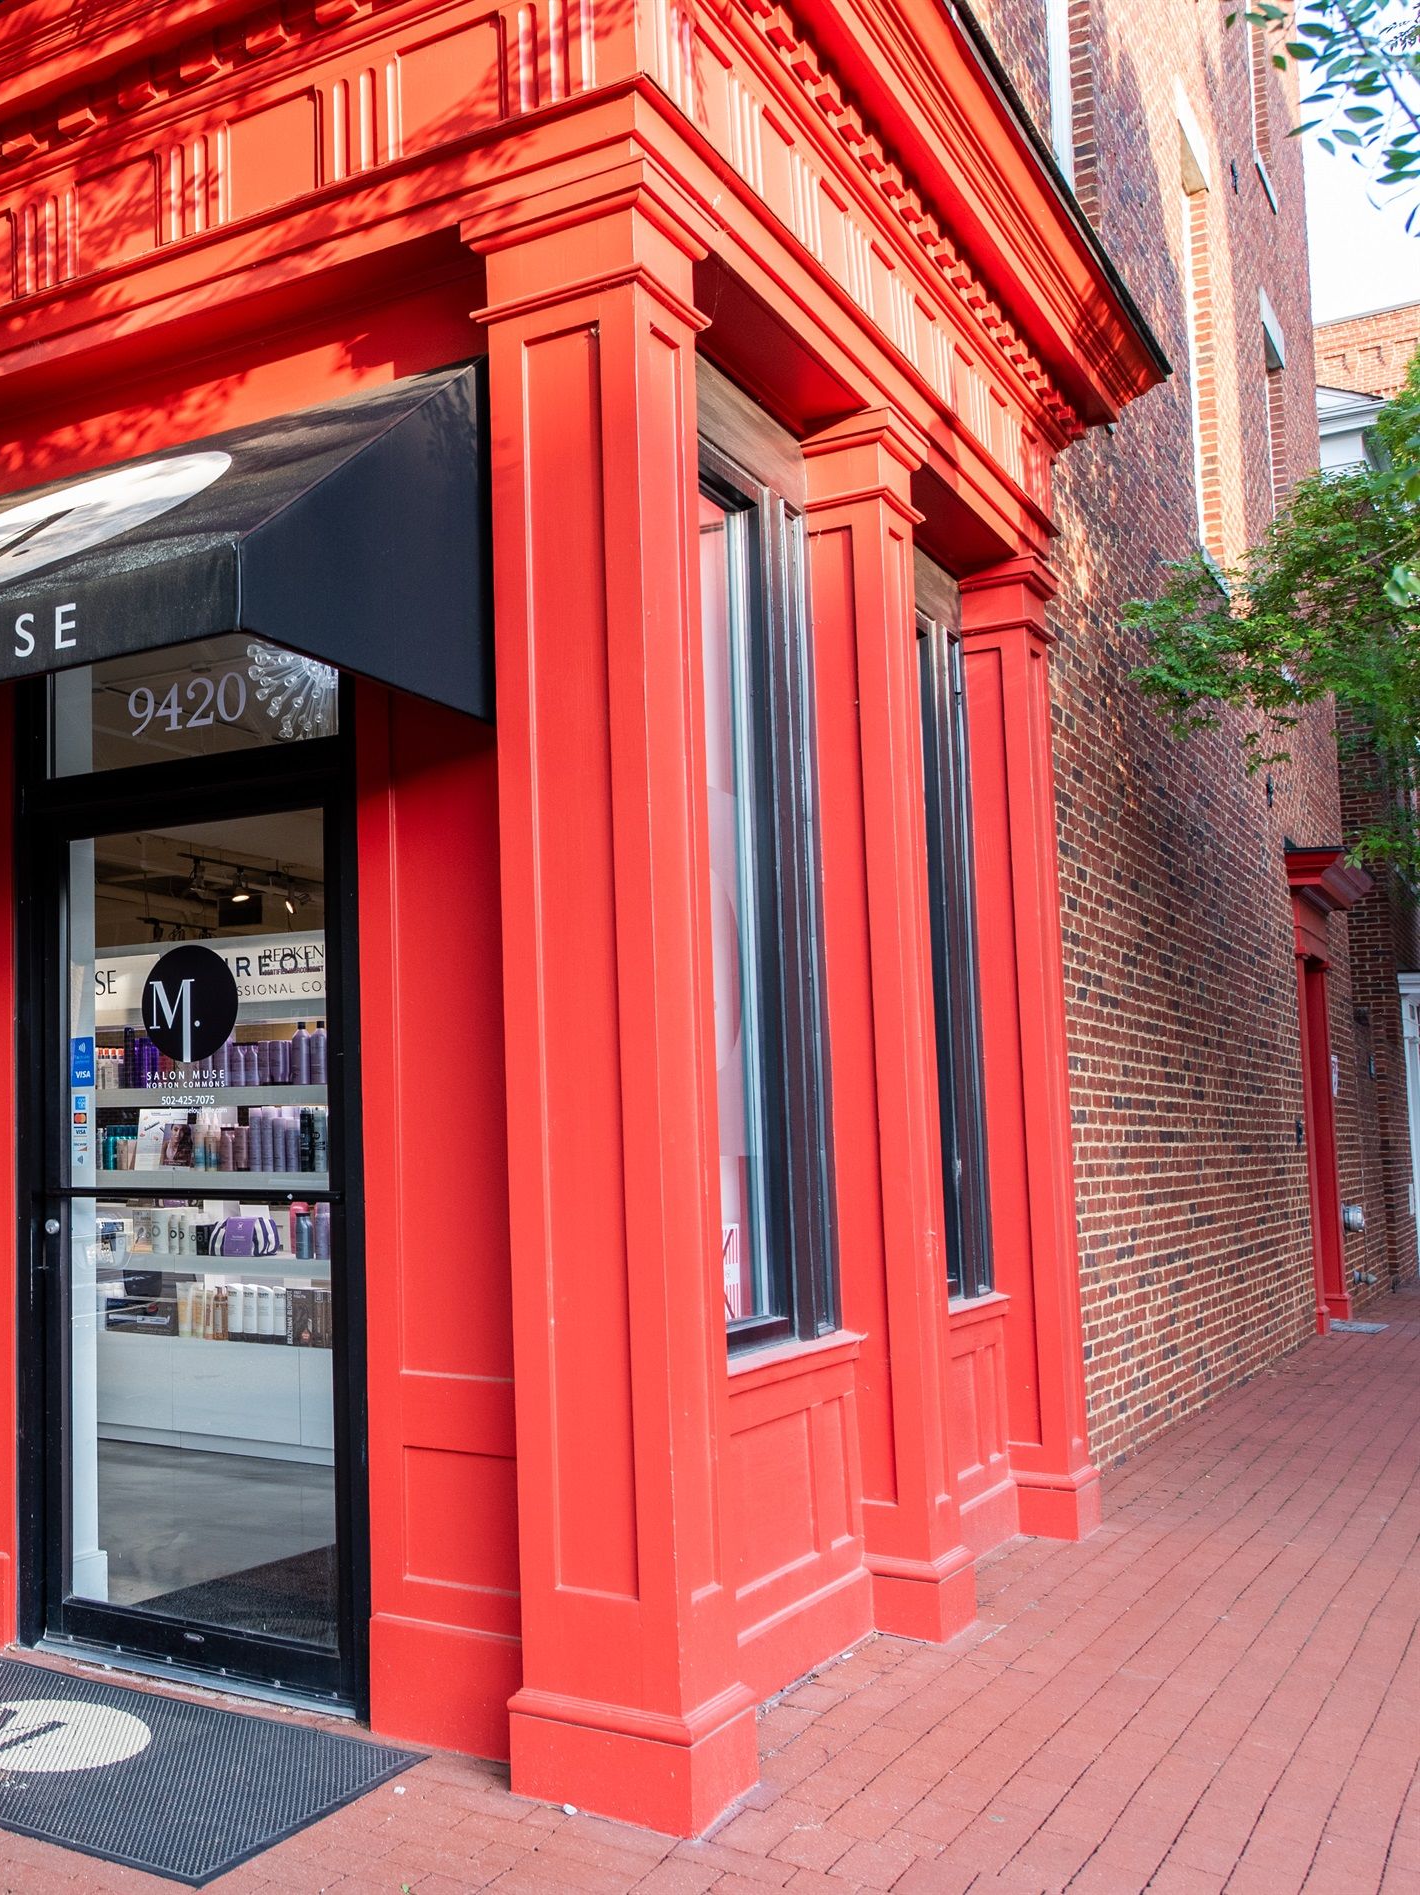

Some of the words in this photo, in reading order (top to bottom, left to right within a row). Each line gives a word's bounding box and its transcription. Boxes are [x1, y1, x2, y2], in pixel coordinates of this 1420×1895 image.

[128, 672, 247, 737] 9420
[263, 944, 324, 963] REDKEN
[74, 1070, 91, 1079] VISA
[146, 1071, 185, 1081] SALON
[192, 1069, 225, 1079] MUSE
[146, 1081, 179, 1089] NORTON
[182, 1080, 225, 1088] COMMONS
[161, 1095, 215, 1105] 502-425-7075
